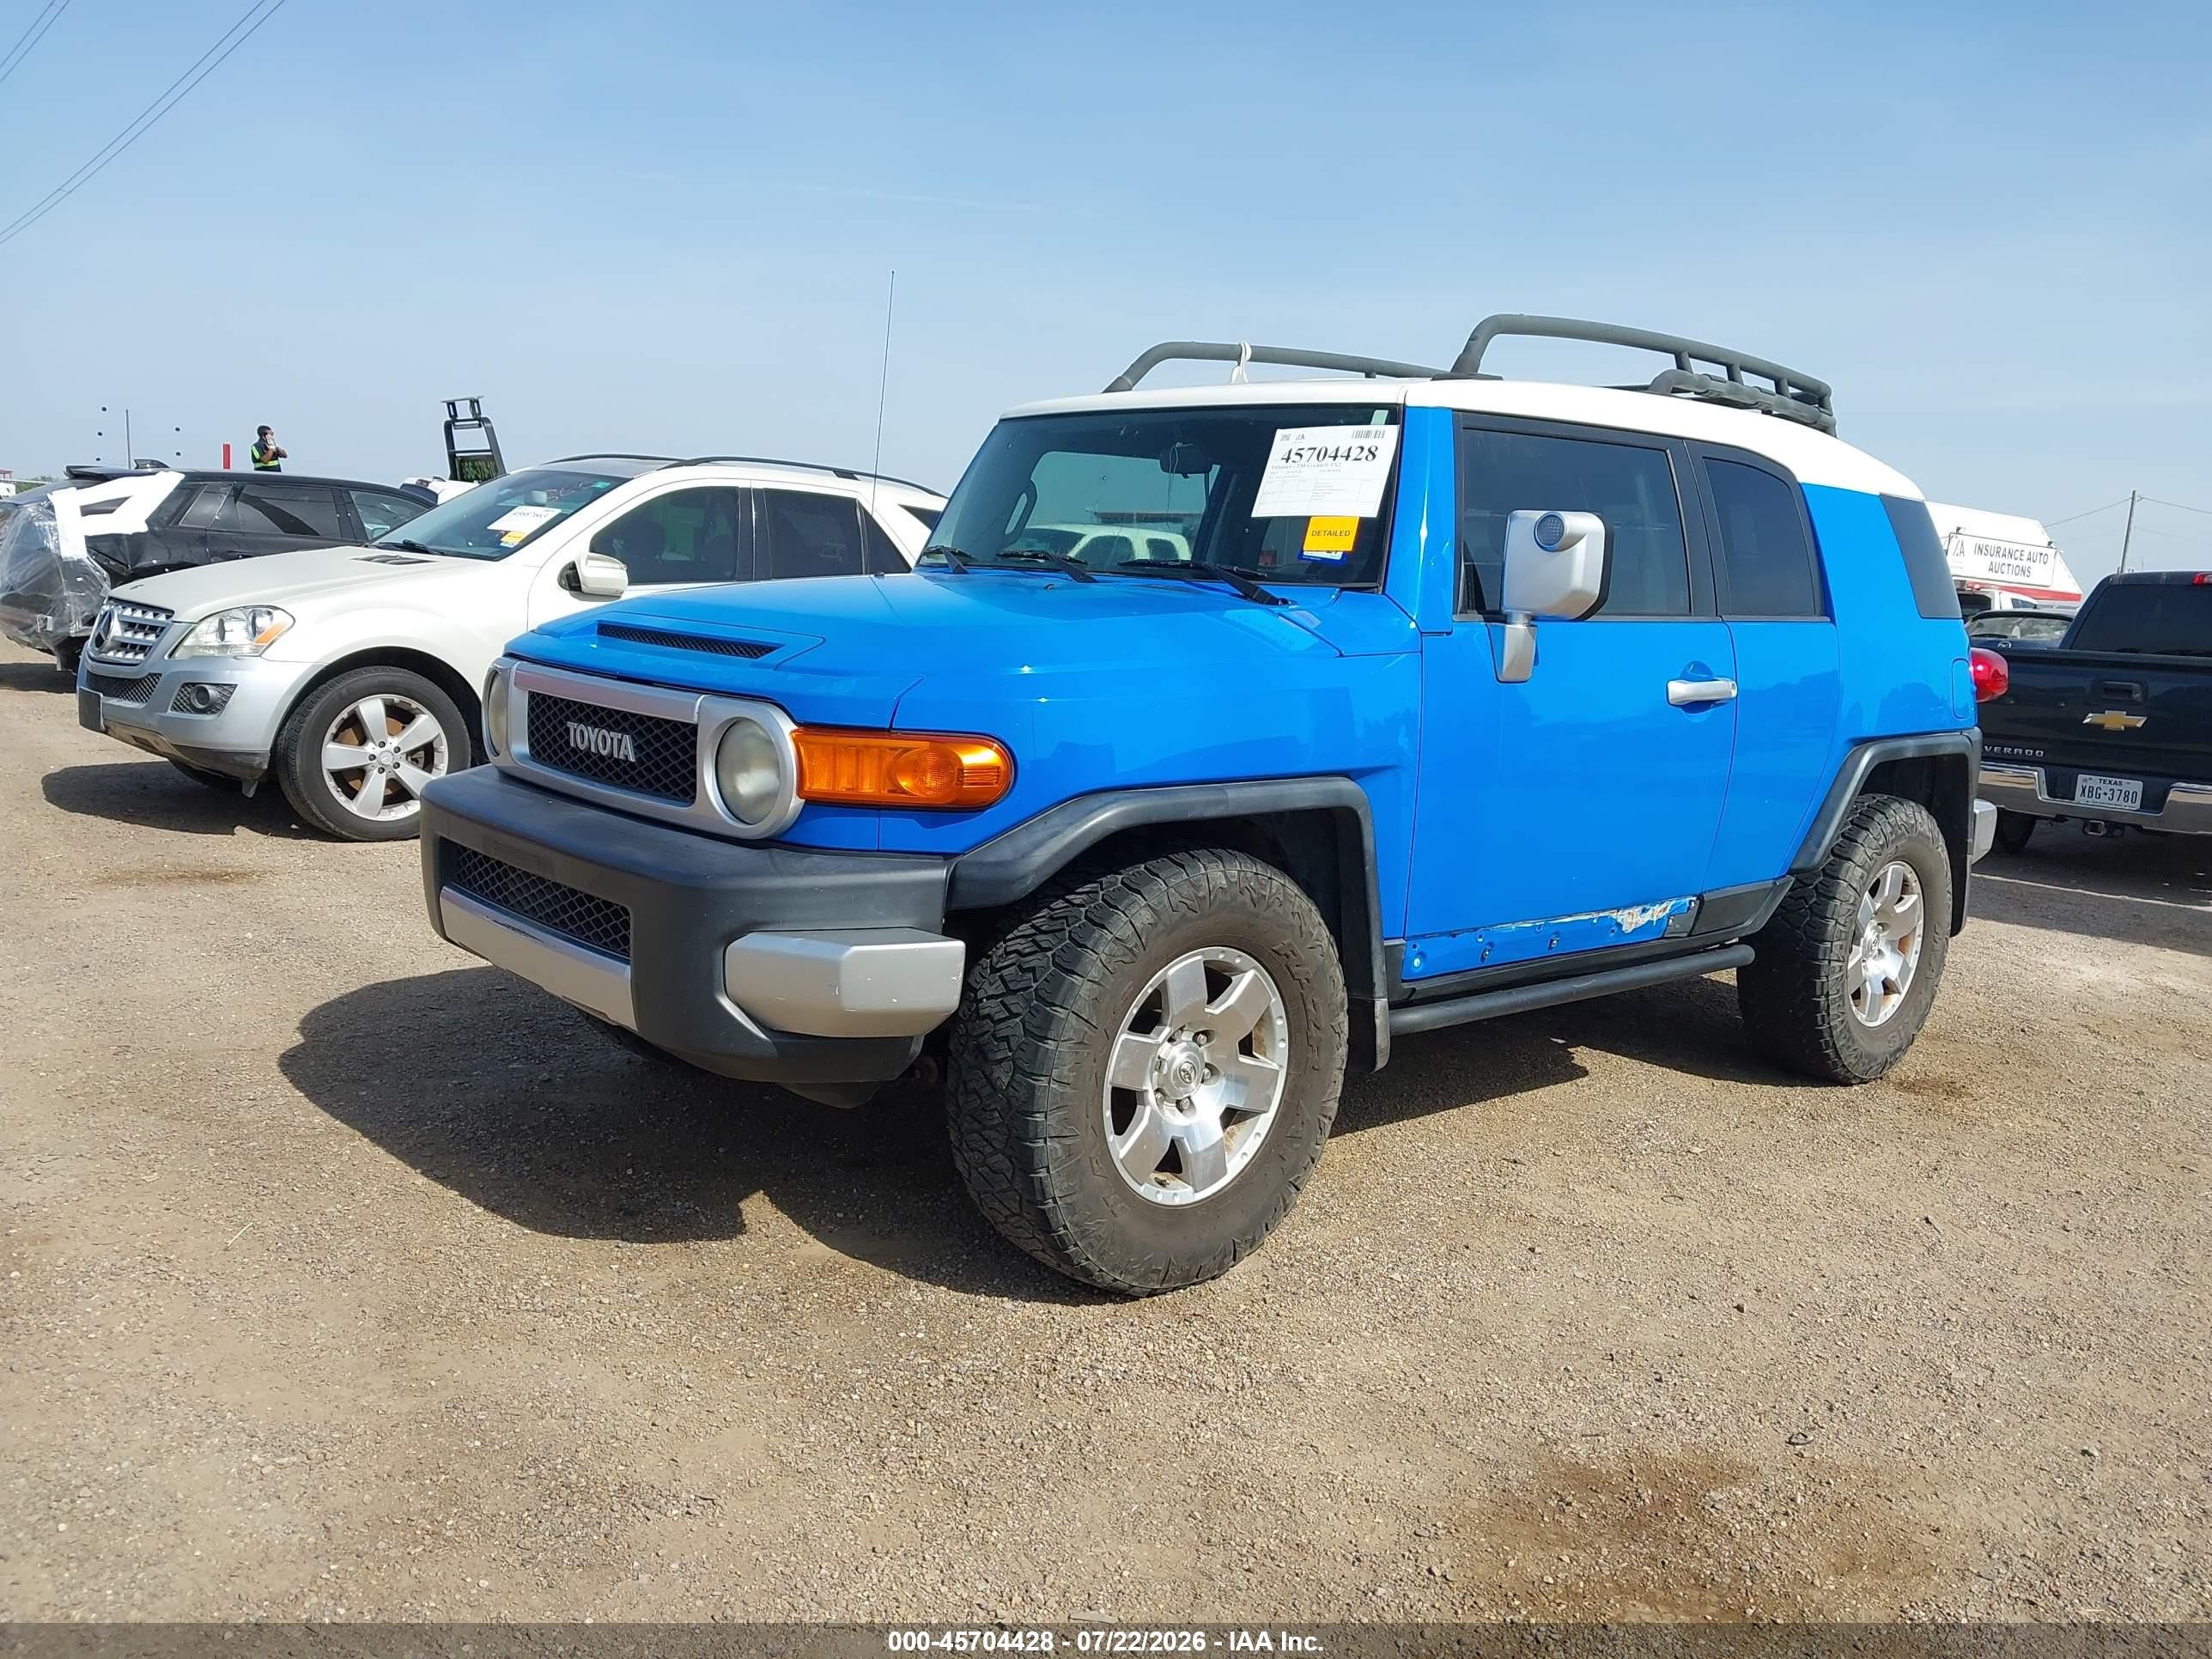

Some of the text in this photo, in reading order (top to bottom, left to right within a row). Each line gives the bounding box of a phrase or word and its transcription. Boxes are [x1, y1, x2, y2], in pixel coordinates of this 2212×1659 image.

[1280, 445, 1378, 464] 45704428
[1311, 529, 1351, 538] DETAILED
[1974, 542, 2049, 564] INSURANCE AUTO
[1988, 561, 2032, 578] AUCTIONS
[567, 721, 635, 763] TOYOTA
[1984, 745, 2045, 757] VERADO
[2098, 778, 2123, 787] TEXAS
